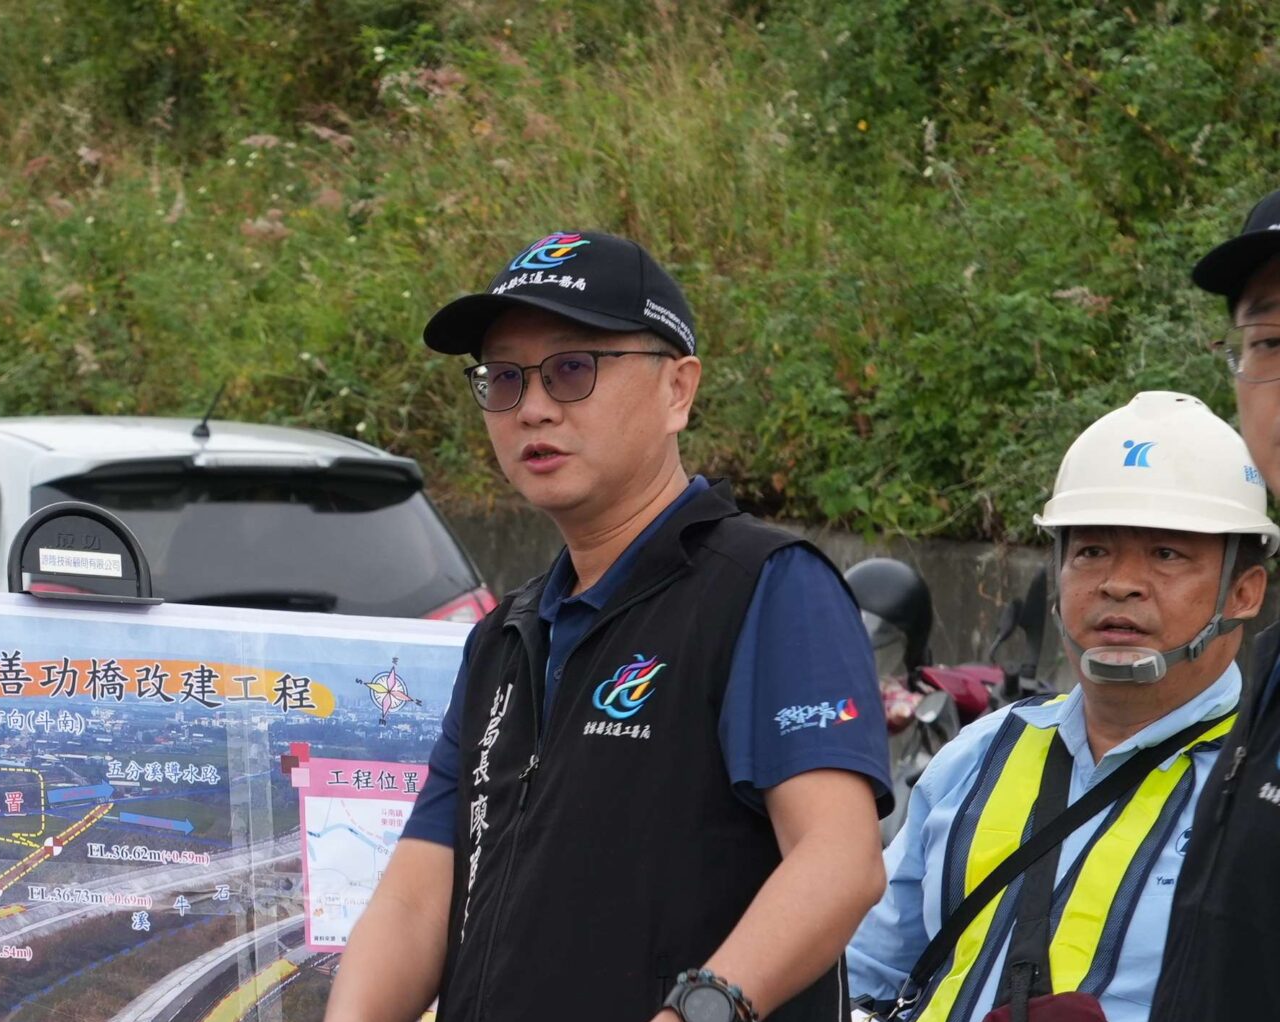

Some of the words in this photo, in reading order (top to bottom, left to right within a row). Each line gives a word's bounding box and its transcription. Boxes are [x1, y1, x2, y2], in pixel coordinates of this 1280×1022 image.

[106, 760, 220, 785] 五分溪導水路
[327, 770, 420, 795] 工程位置
